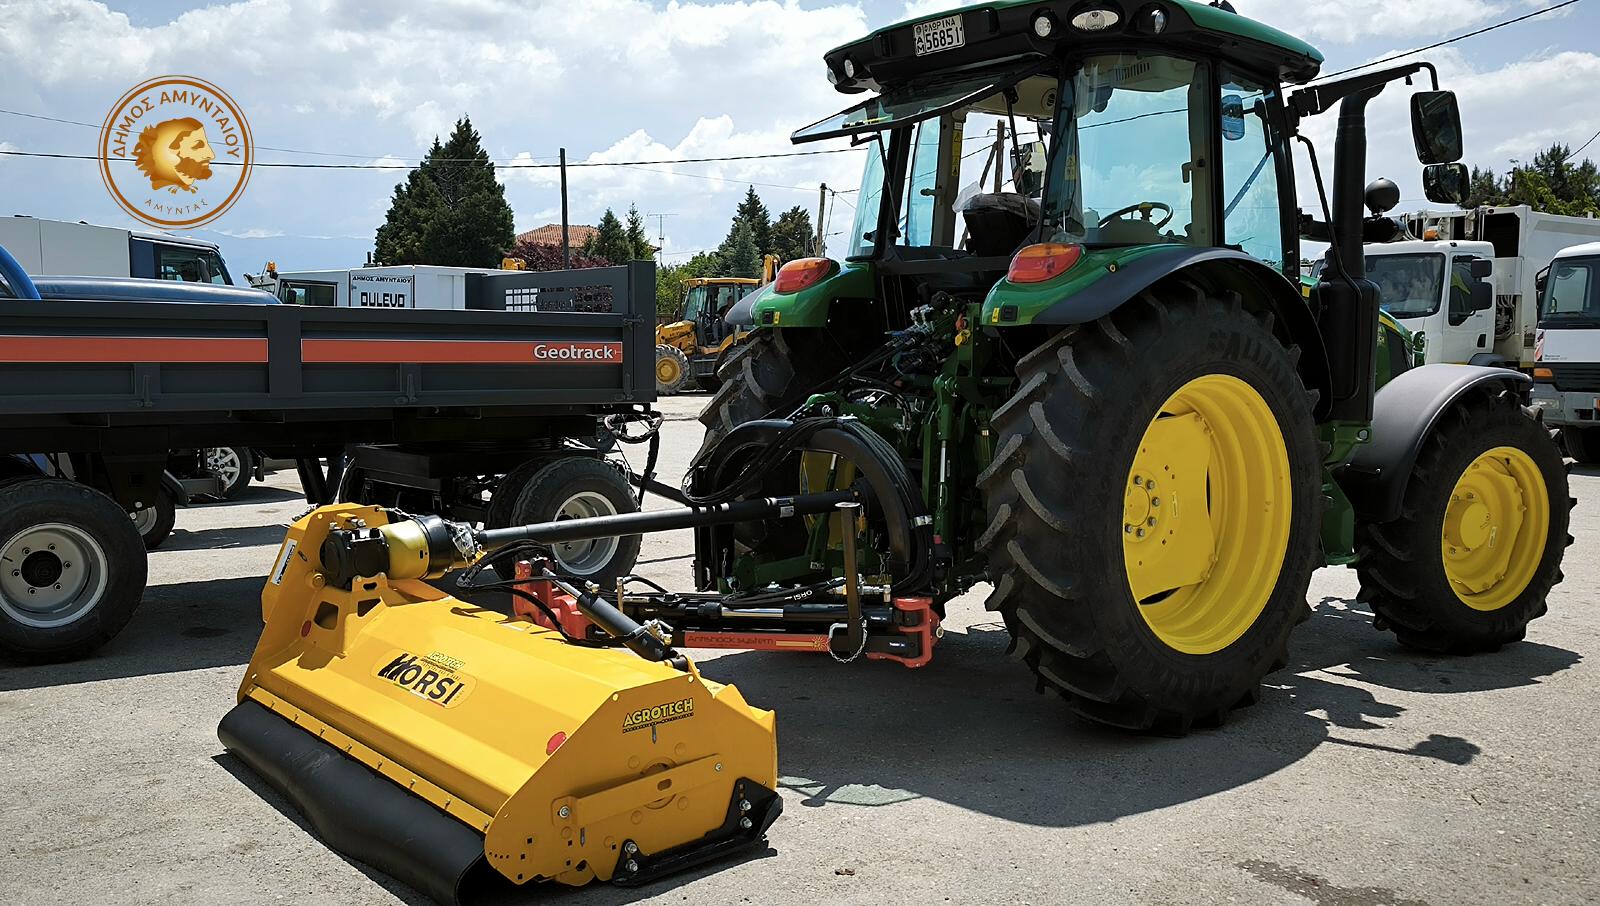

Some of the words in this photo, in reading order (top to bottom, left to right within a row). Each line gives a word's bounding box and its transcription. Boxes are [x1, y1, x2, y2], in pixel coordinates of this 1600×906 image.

[925, 26, 960, 50] 56851
[360, 291, 406, 308] DULEVO
[533, 344, 613, 360] Geotrack
[622, 697, 694, 728] AGROTECH
